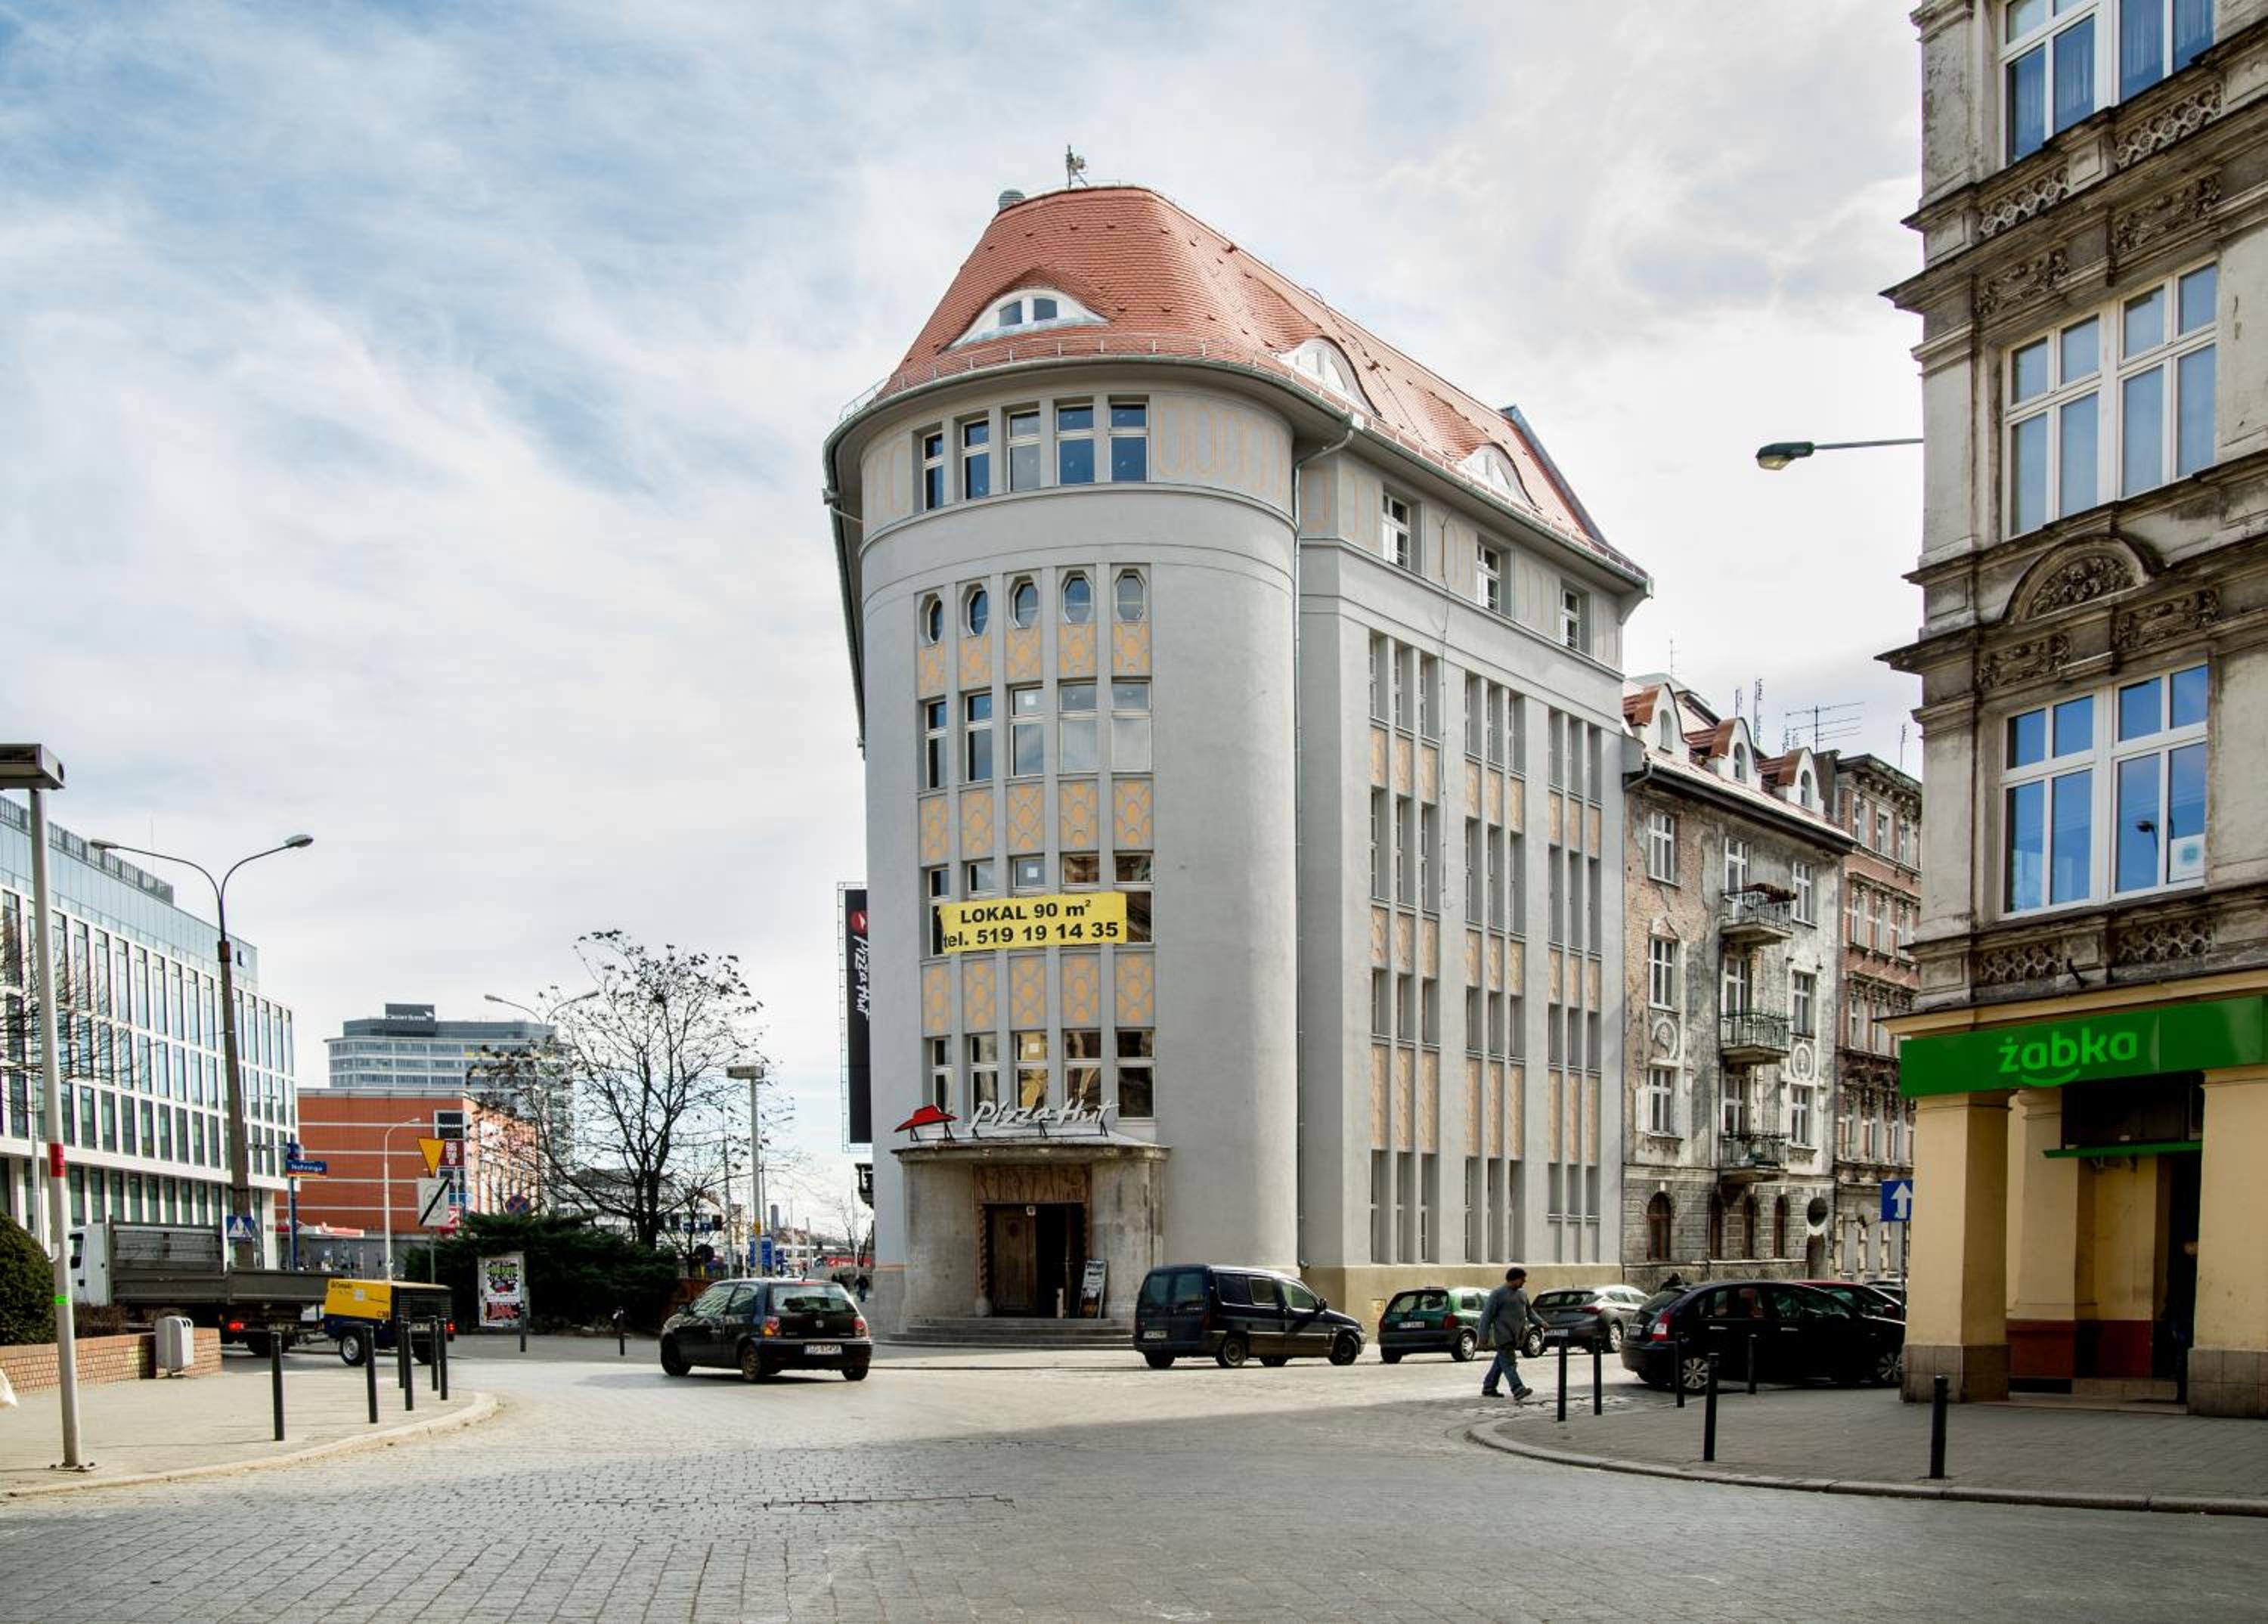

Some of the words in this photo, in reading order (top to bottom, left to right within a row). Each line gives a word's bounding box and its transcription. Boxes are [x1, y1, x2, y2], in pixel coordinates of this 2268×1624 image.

[960, 905, 1027, 924] LOKAL
[1033, 902, 1058, 919] 90
[943, 931, 969, 948] tel.
[976, 926, 1014, 944] 519
[1022, 925, 1047, 941] 19
[1055, 922, 1083, 939] 14
[1091, 922, 1119, 938] 35
[852, 934, 869, 983] Pizza
[855, 984, 870, 1021] Hut
[1998, 1027, 2139, 1073] żabka
[969, 1100, 1055, 1132] Pizza
[1056, 1097, 1120, 1126] Hut
